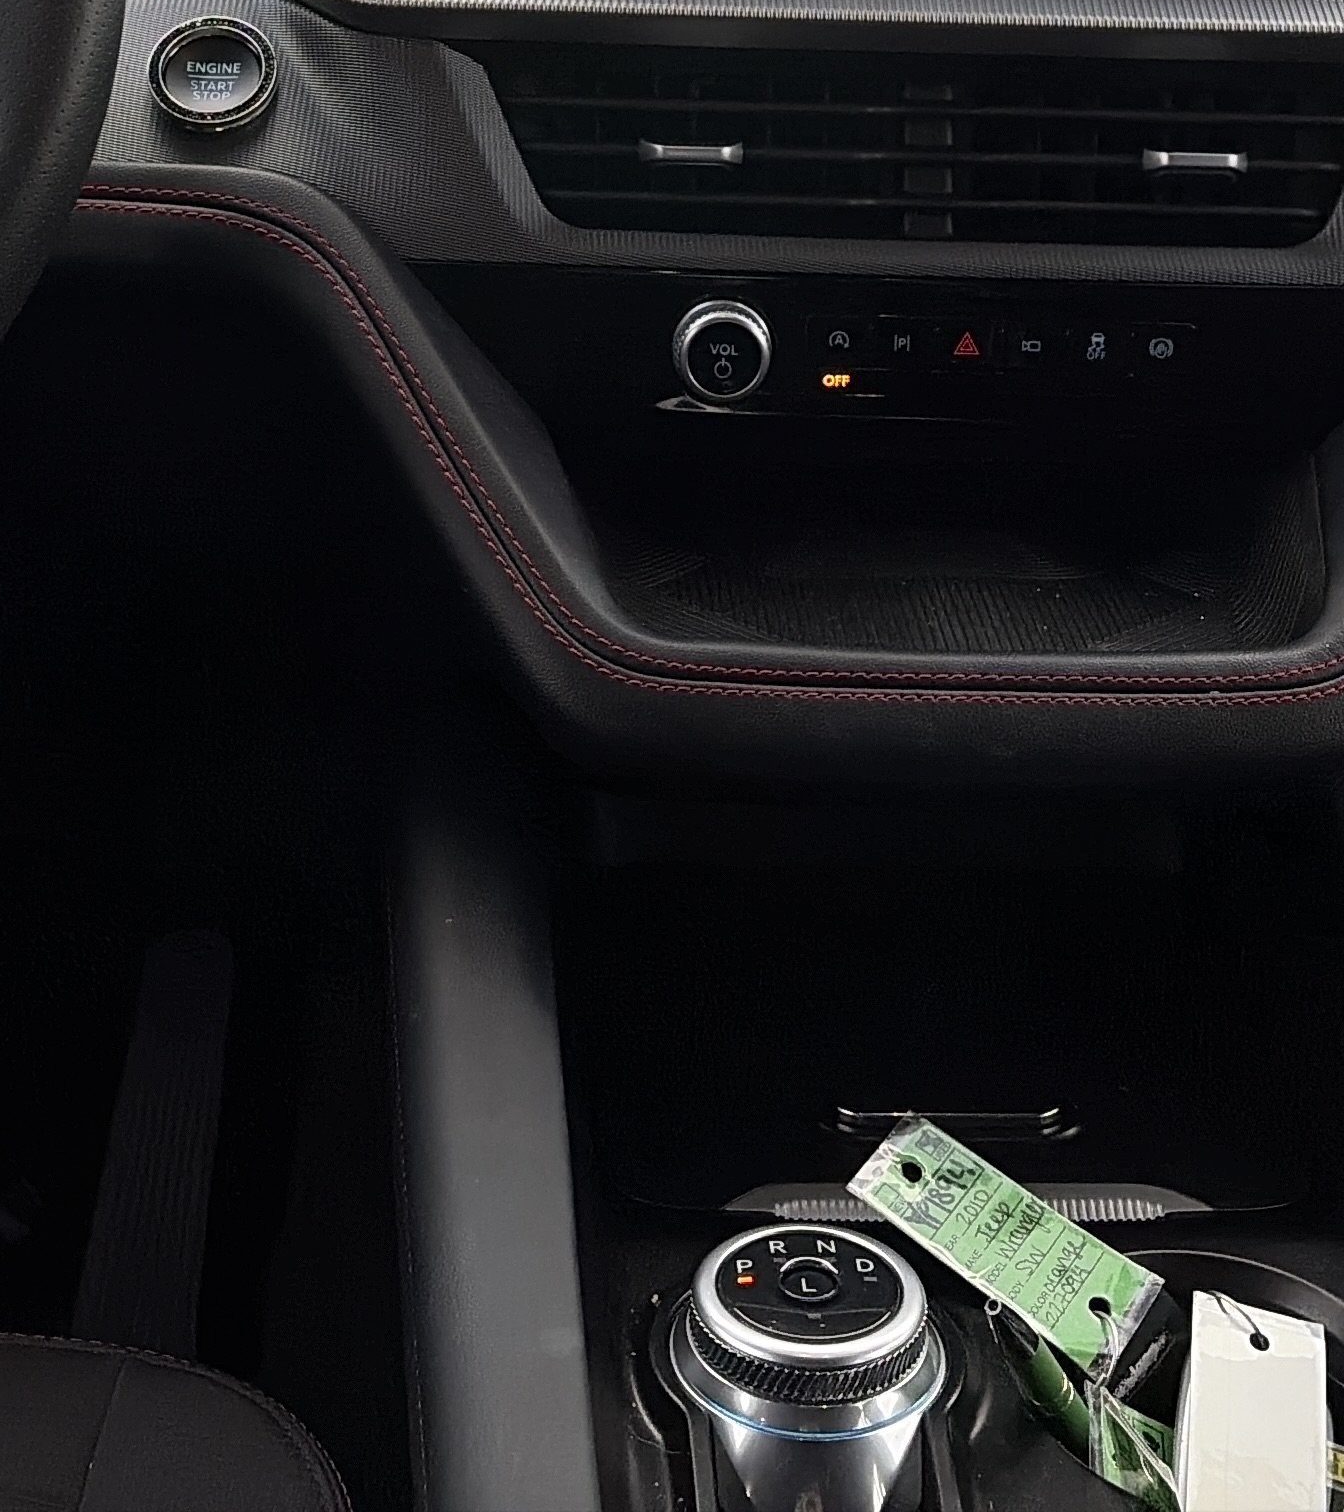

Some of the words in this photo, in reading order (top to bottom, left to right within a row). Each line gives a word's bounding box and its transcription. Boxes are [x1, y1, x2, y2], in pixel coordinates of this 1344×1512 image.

[186, 61, 242, 74] ENGINE
[190, 80, 235, 91] START
[192, 90, 231, 101] STOP
[709, 343, 739, 356] VOL
[1086, 351, 1106, 360] OFF
[821, 374, 851, 387] OFF
[955, 1188, 991, 1226] 2010
[974, 1201, 1014, 1246] Jeep
[769, 1240, 787, 1255] R
[817, 1239, 837, 1254] N
[736, 1259, 753, 1274] P
[856, 1258, 875, 1273] D
[800, 1277, 817, 1293] L
